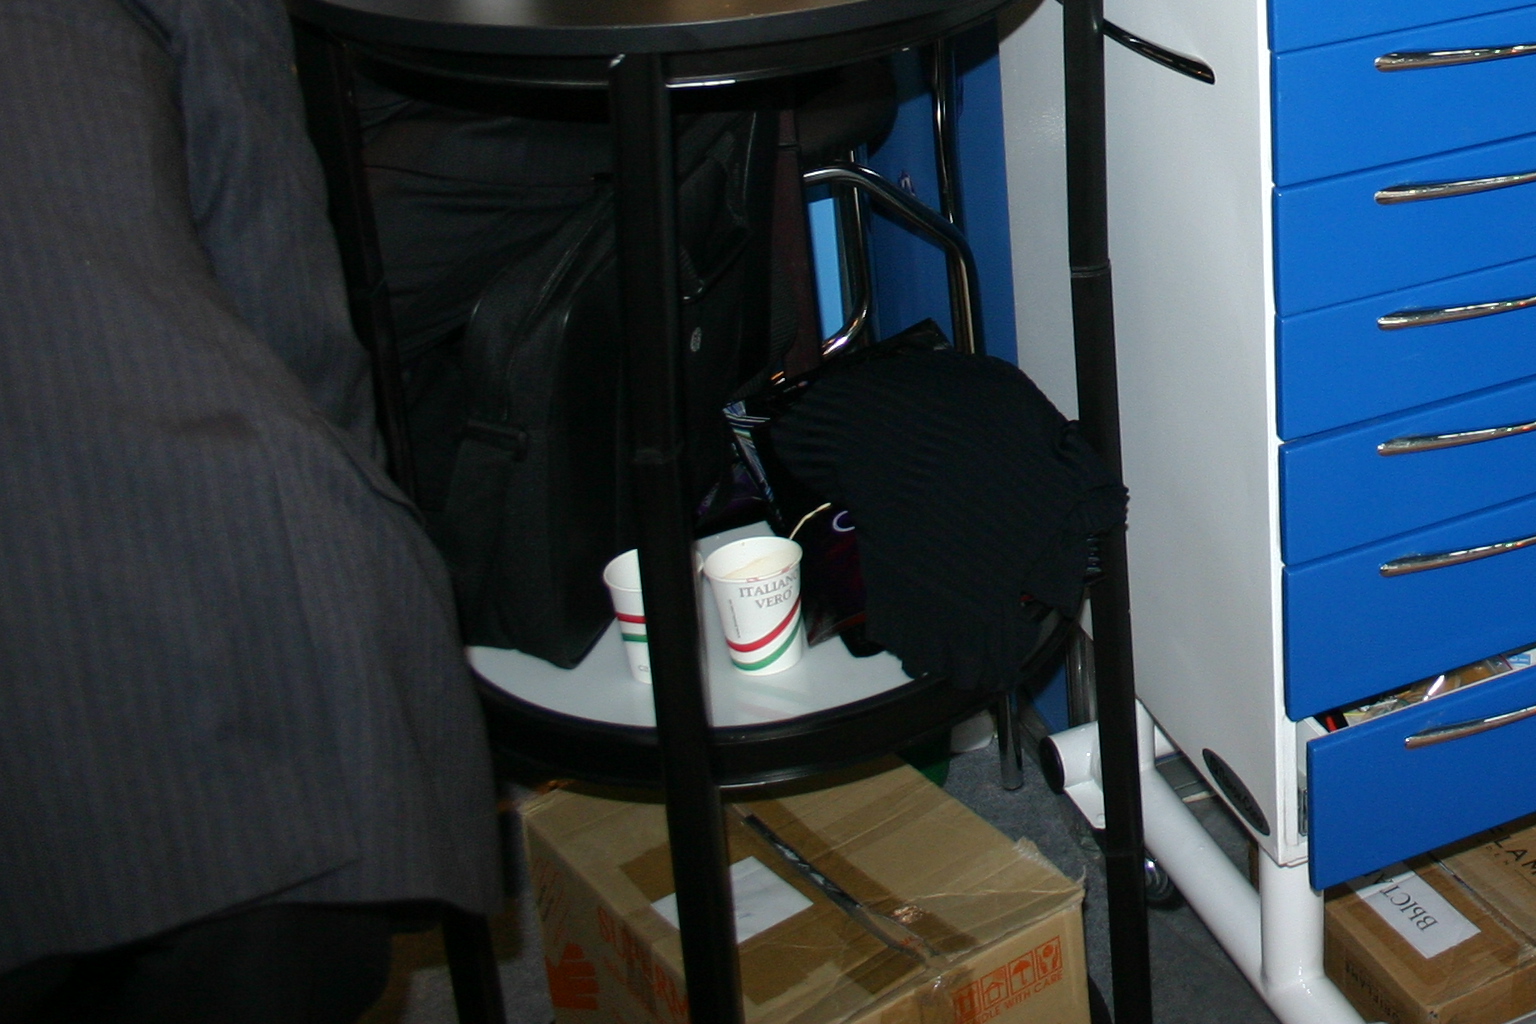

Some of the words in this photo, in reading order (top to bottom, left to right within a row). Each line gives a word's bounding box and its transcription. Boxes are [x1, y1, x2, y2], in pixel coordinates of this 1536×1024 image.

[739, 570, 798, 597] ITALIAN
[1004, 990, 1031, 1009] WITH
[1034, 973, 1063, 993] CARE
